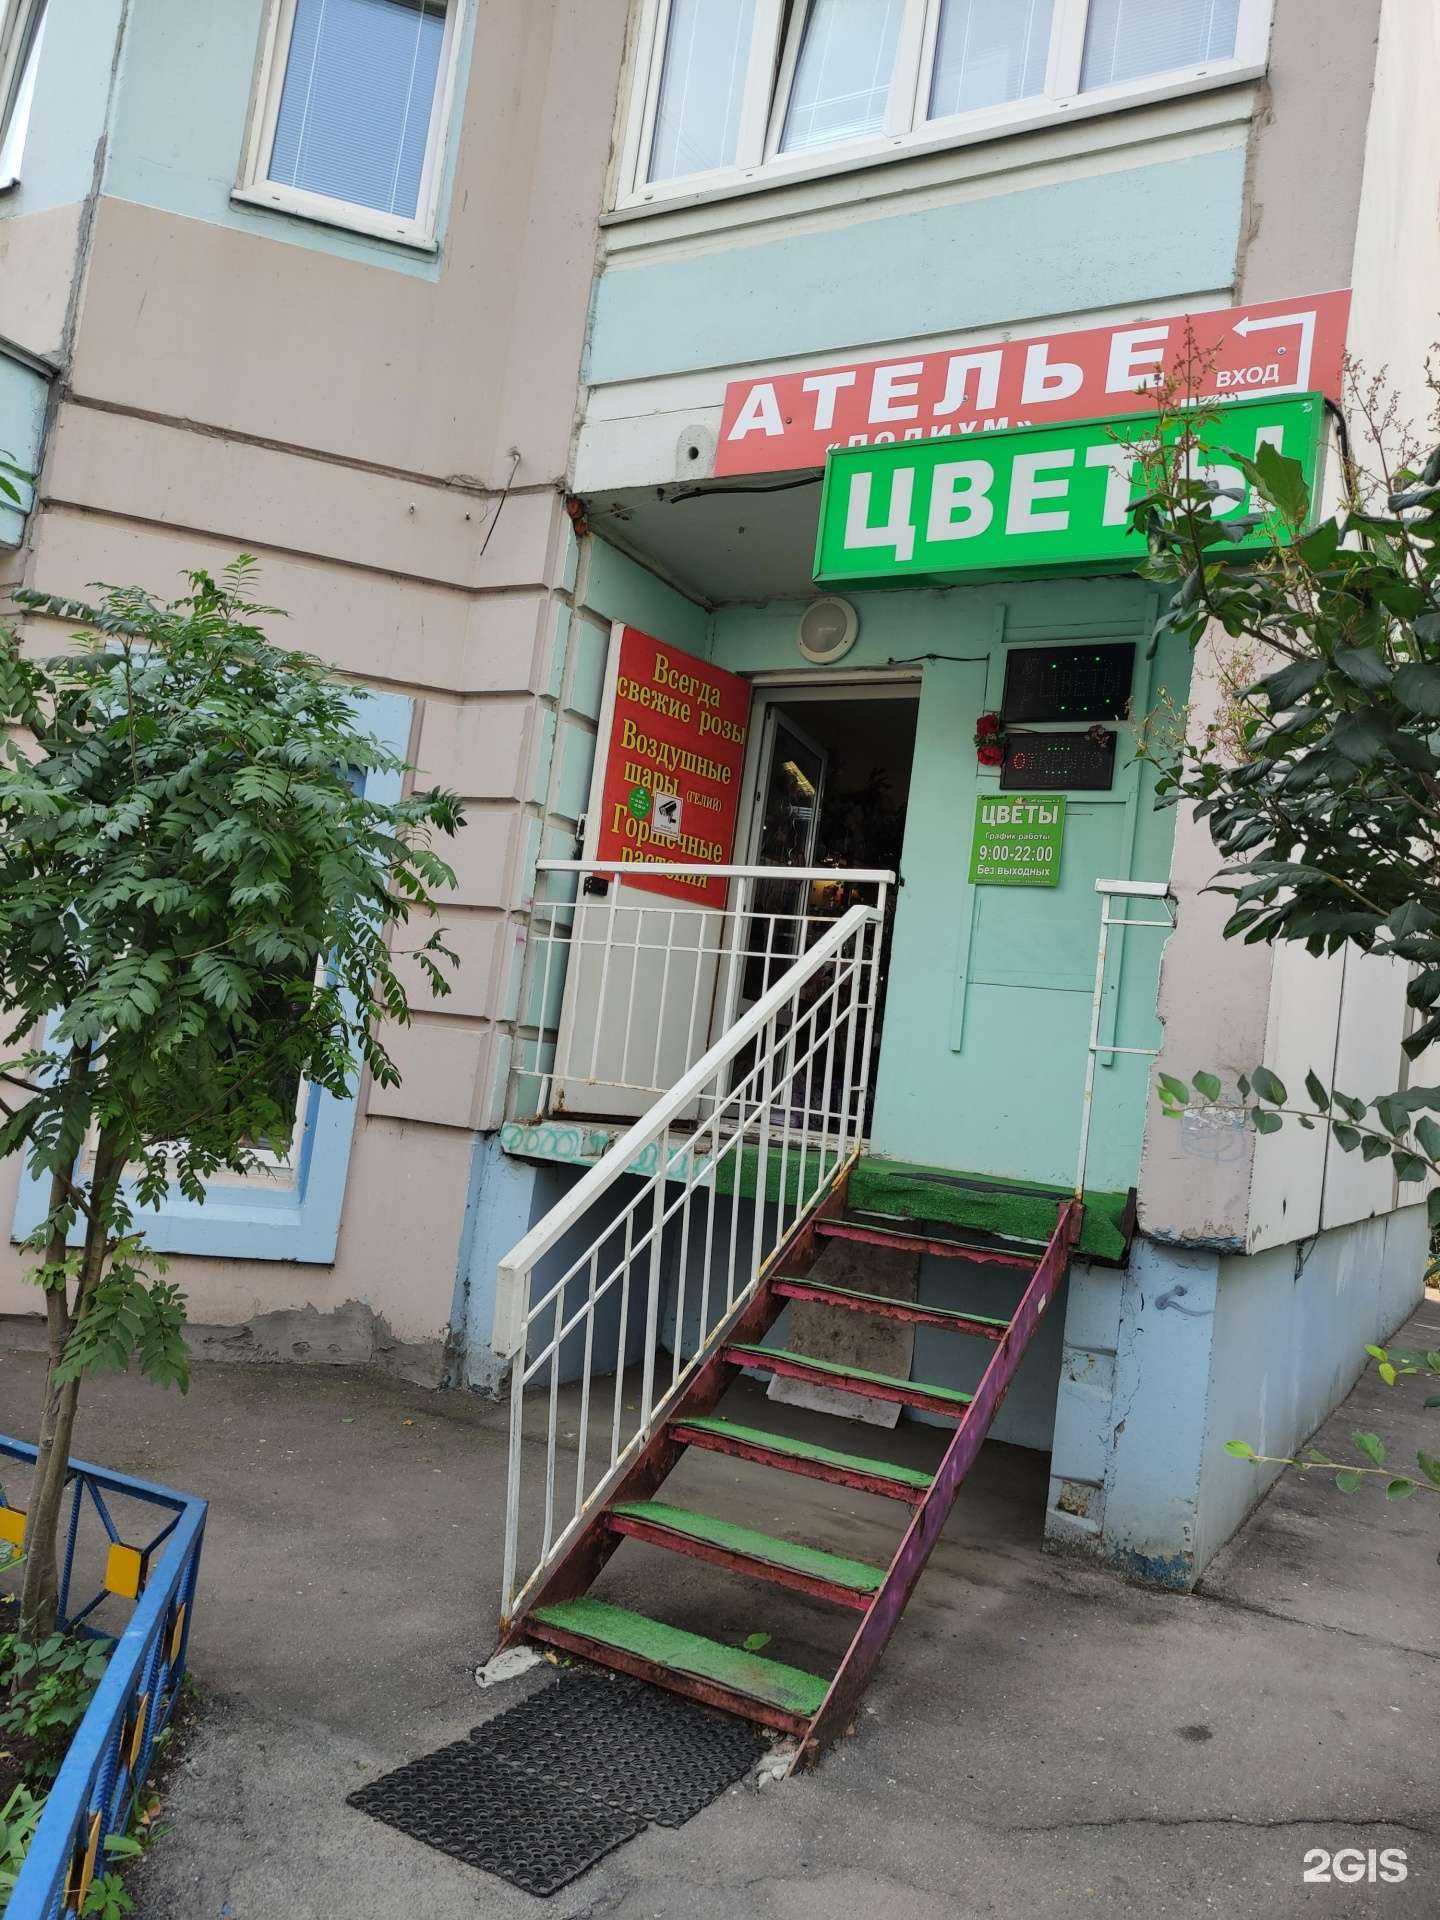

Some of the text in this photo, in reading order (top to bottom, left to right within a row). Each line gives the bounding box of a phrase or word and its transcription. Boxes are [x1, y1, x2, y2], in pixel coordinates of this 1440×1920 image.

[728, 325, 1170, 440] АТЕЛЬЕ
[1216, 364, 1279, 387] ВХОД
[843, 424, 1285, 561] ЦВЕТЫ
[652, 652, 721, 708] Всегда
[617, 675, 746, 745] свежие розы
[620, 718, 732, 785] Воздушные
[624, 761, 680, 797] шары
[981, 805, 1059, 826] ЦВЕТЫ
[979, 845, 1053, 862] 9:00-22:00
[985, 832, 1050, 841] График работы
[977, 864, 1050, 877] Без выходных
